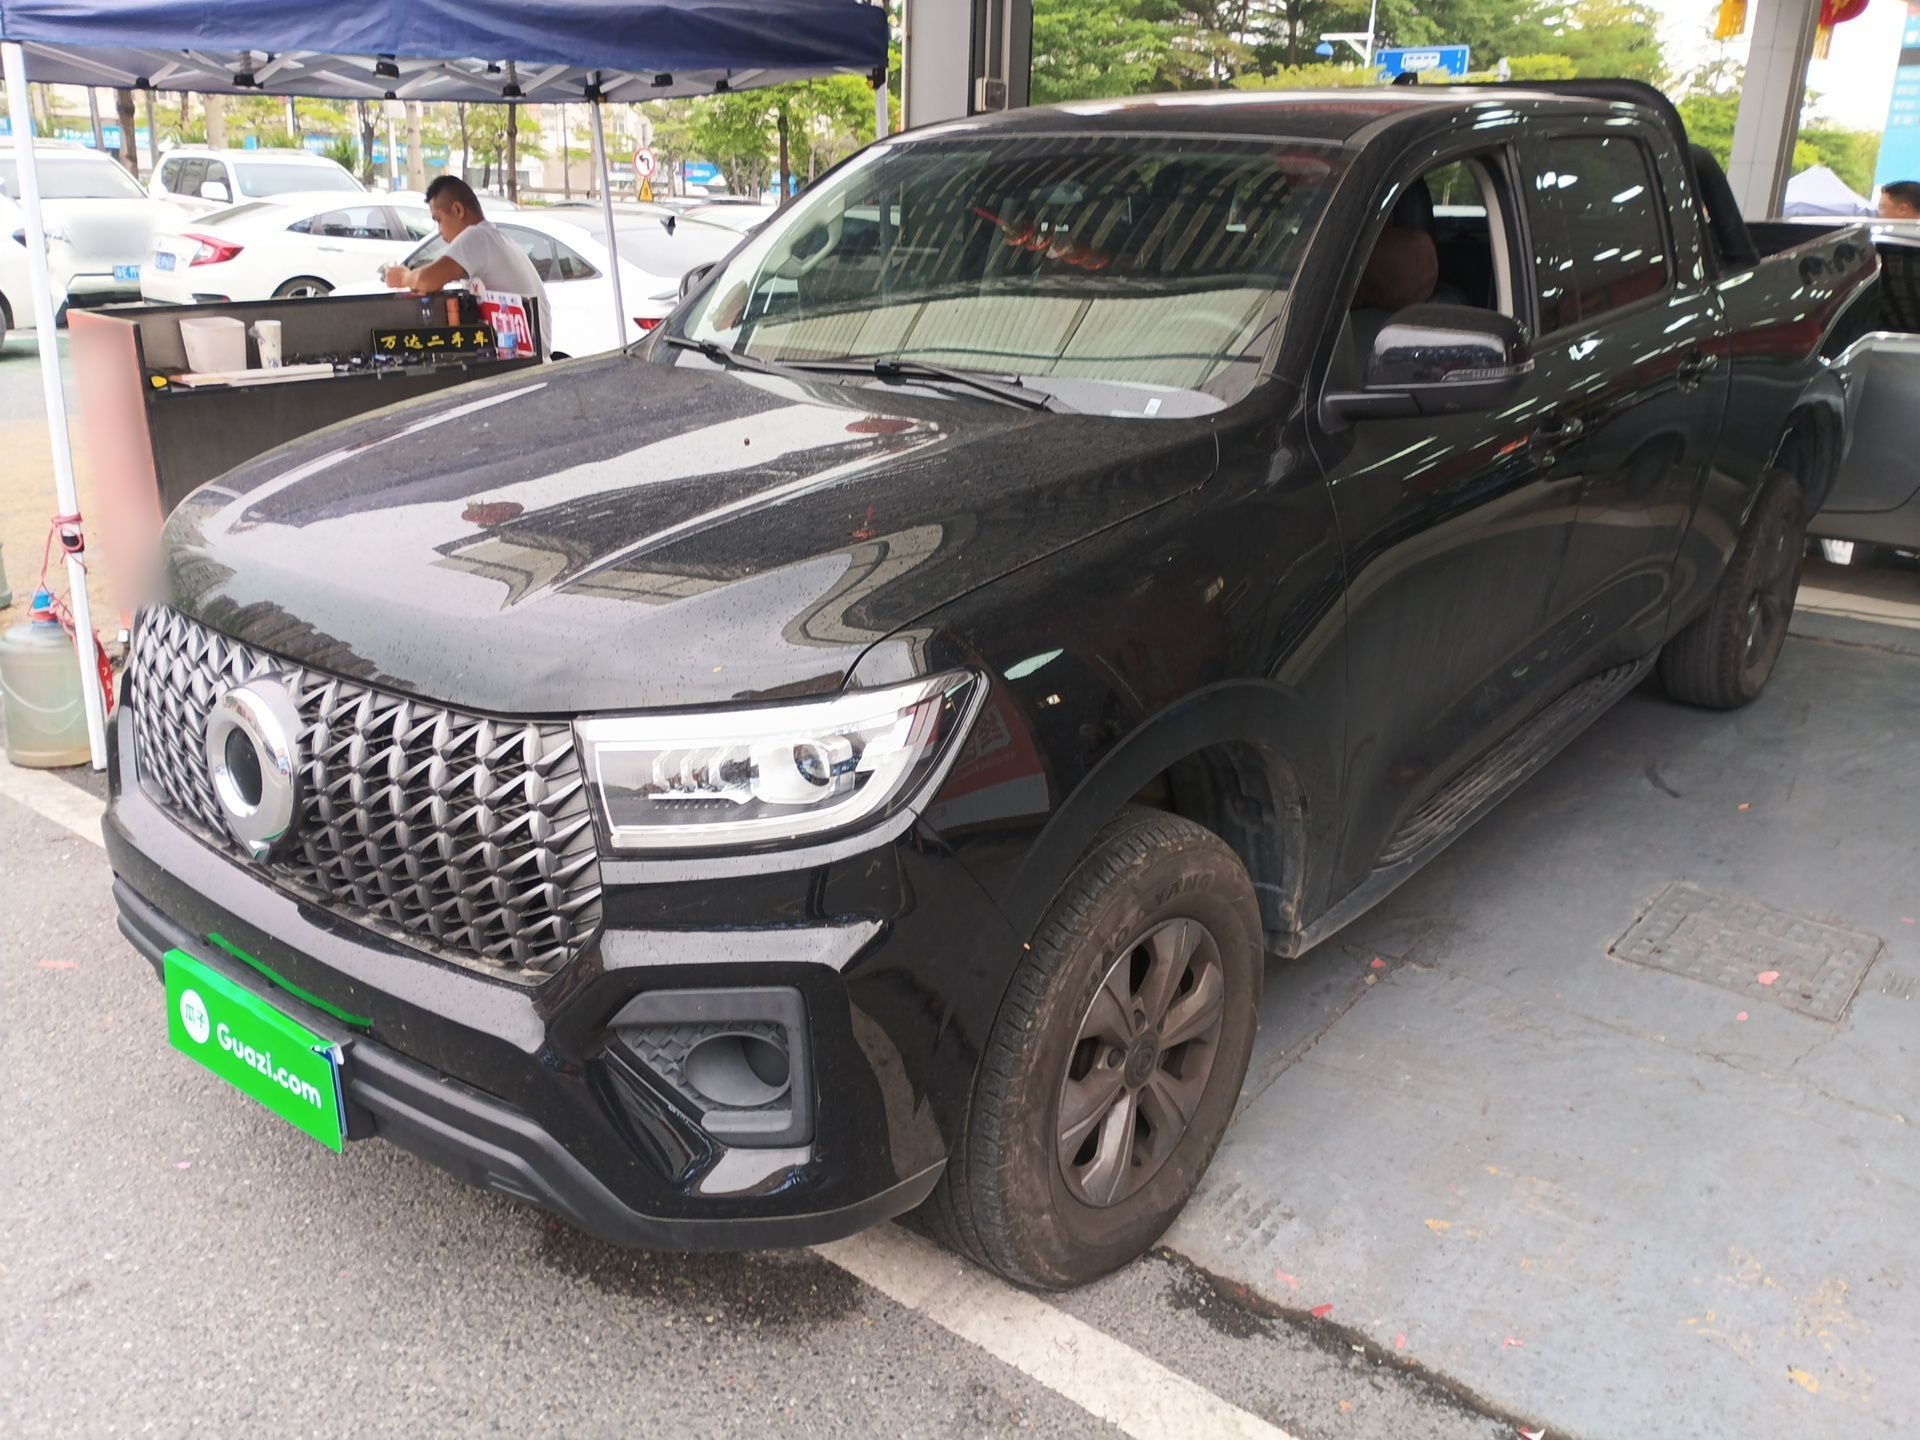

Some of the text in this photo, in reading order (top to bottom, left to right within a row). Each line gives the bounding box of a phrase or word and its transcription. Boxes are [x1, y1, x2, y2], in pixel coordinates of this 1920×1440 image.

[381, 330, 489, 349] 万达二手车
[1155, 870, 1215, 906] YANG
[216, 1022, 322, 1109] Guazi.com
